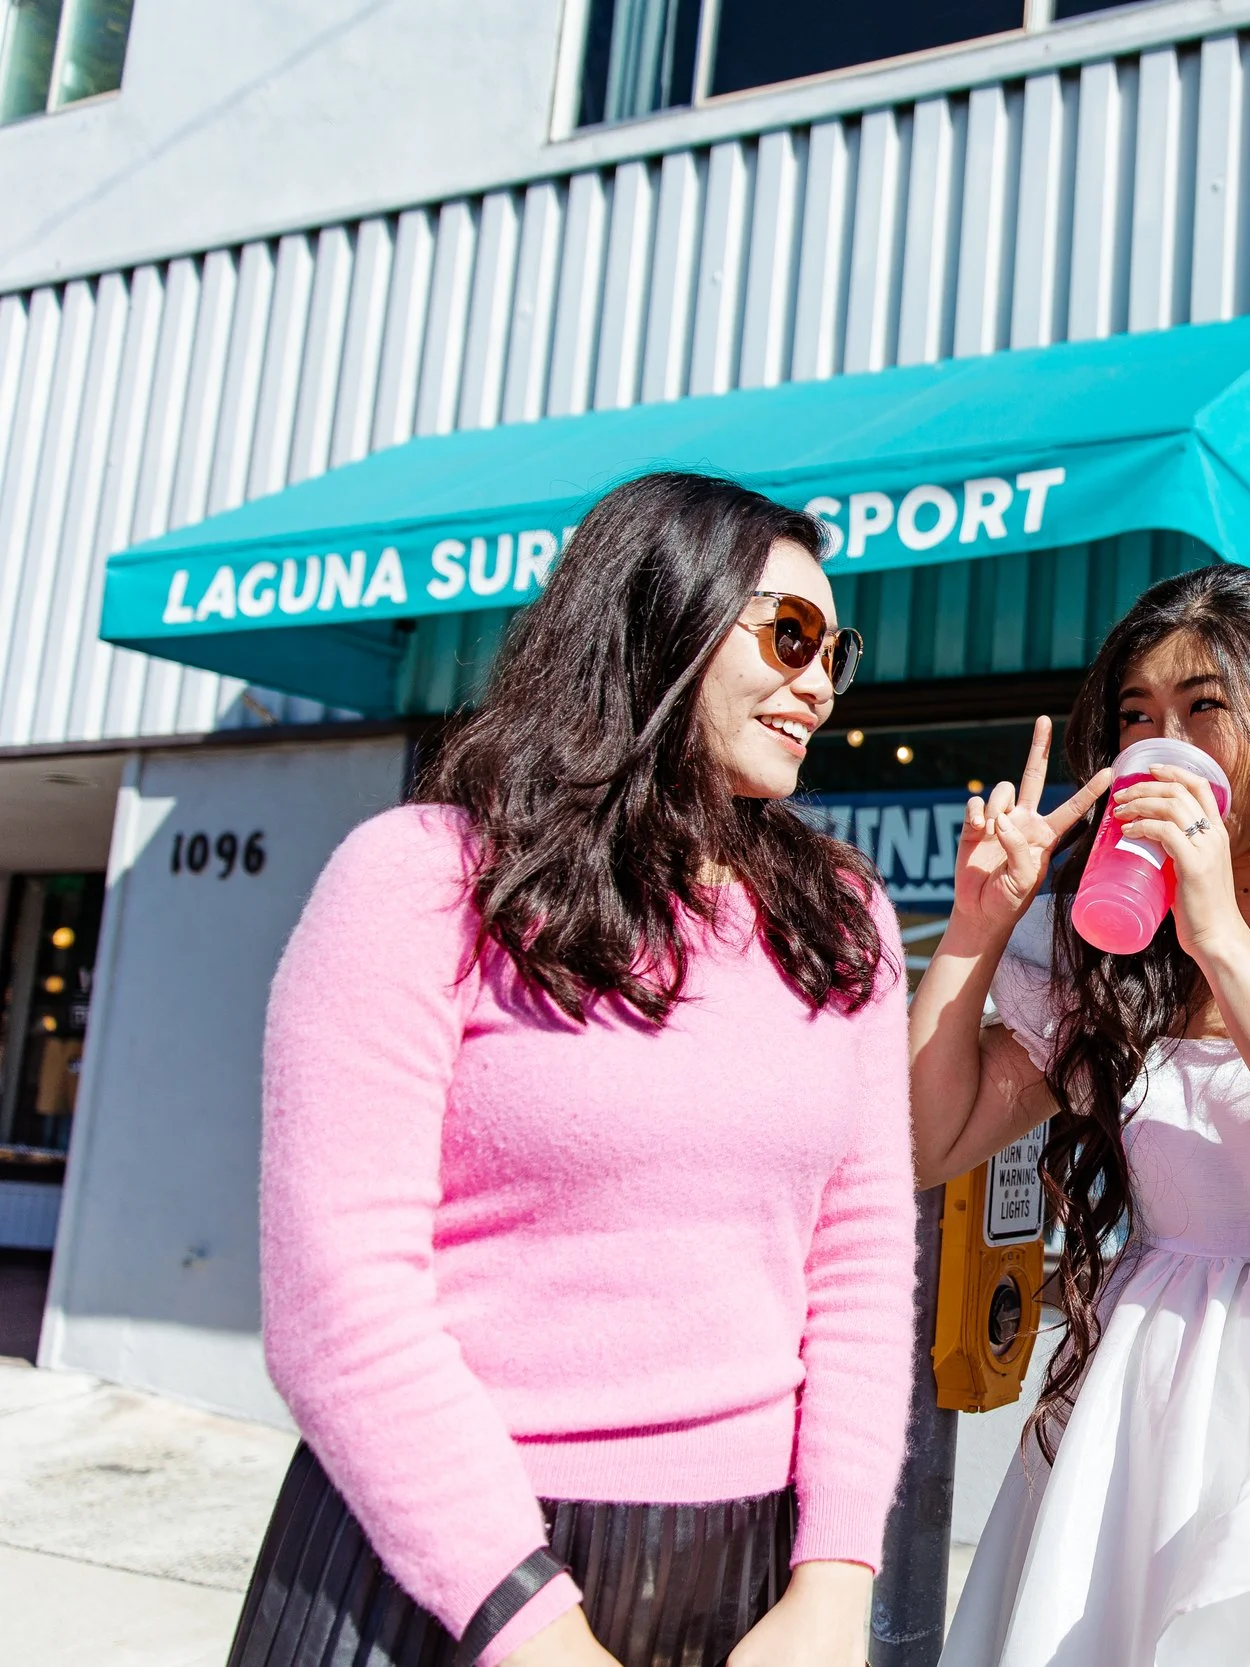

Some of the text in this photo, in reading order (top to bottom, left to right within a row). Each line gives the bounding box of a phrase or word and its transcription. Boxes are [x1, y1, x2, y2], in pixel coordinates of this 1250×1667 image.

[162, 547, 408, 624] LAGUNA
[804, 467, 1066, 559] SPORT
[171, 830, 266, 880] 1096
[1027, 1145, 1039, 1163] ON
[1000, 1167, 1036, 1188] WARNING
[1001, 1200, 1030, 1220] LIGHTS
